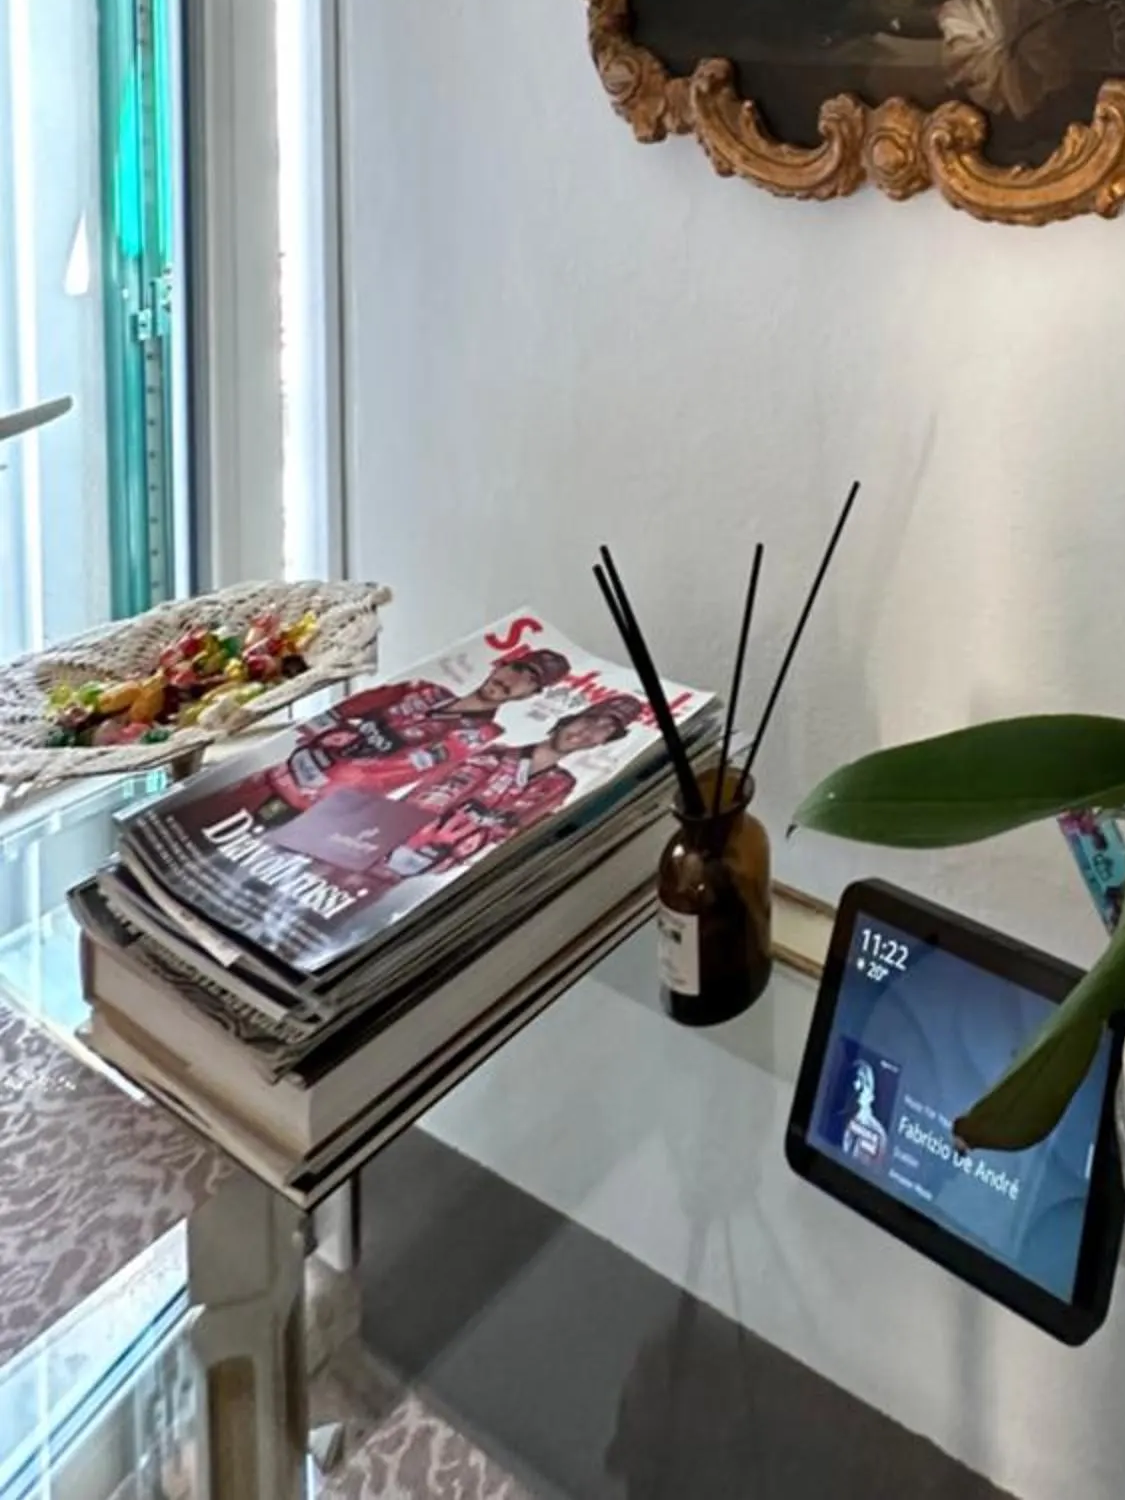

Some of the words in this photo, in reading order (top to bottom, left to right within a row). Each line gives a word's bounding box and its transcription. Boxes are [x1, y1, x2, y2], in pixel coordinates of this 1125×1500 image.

[861, 929, 909, 971] 11:22
[898, 1115, 951, 1161] Fabrizio
[974, 1160, 1020, 1200] André
